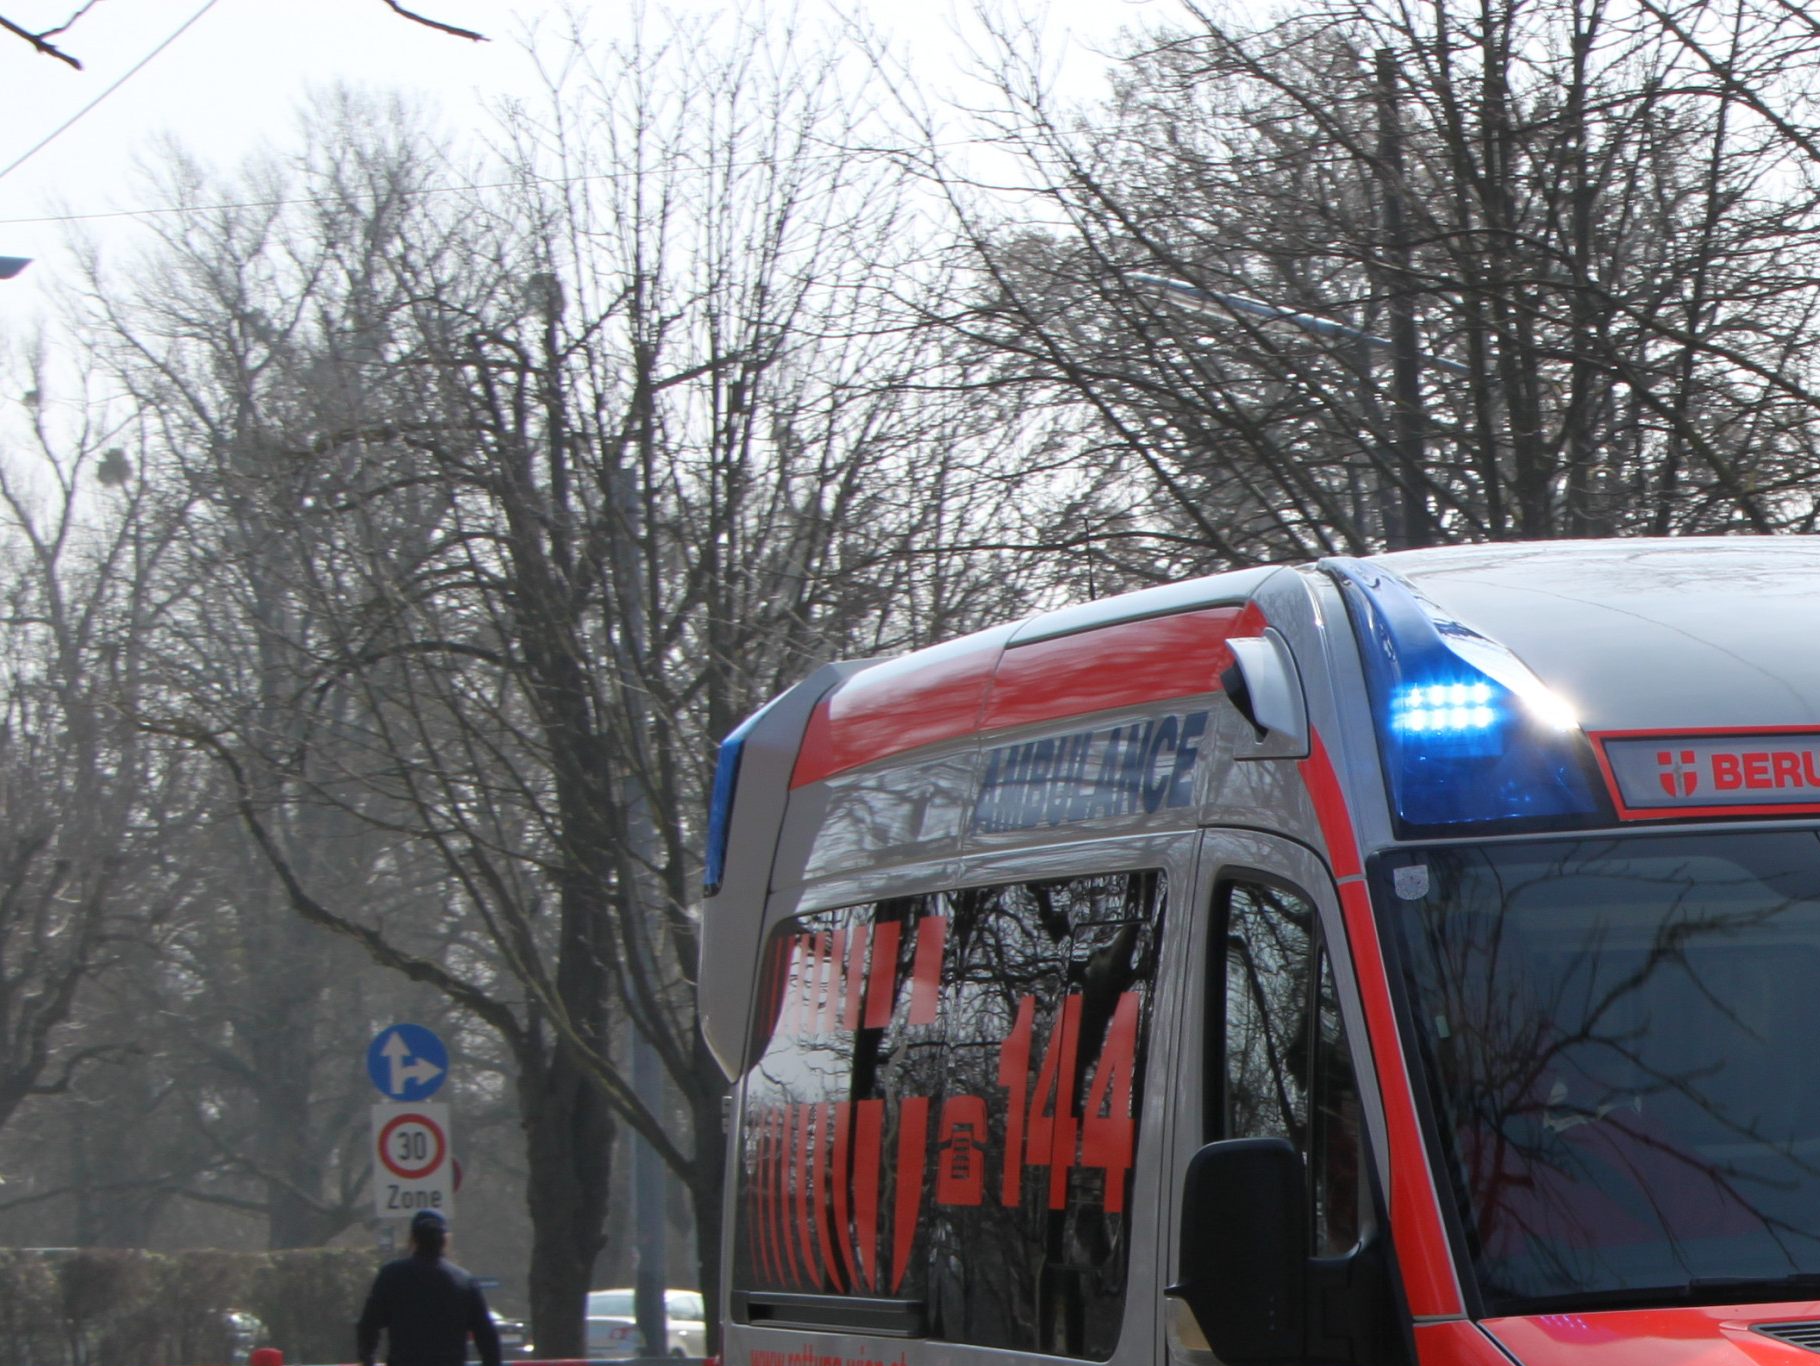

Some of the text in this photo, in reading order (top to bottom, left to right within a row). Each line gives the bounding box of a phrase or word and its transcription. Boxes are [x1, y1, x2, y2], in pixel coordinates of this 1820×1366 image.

[970, 711, 1209, 836] AMBULANCE
[997, 991, 1140, 1213] 144
[397, 1131, 427, 1160] 30
[387, 1184, 442, 1209] Zone
